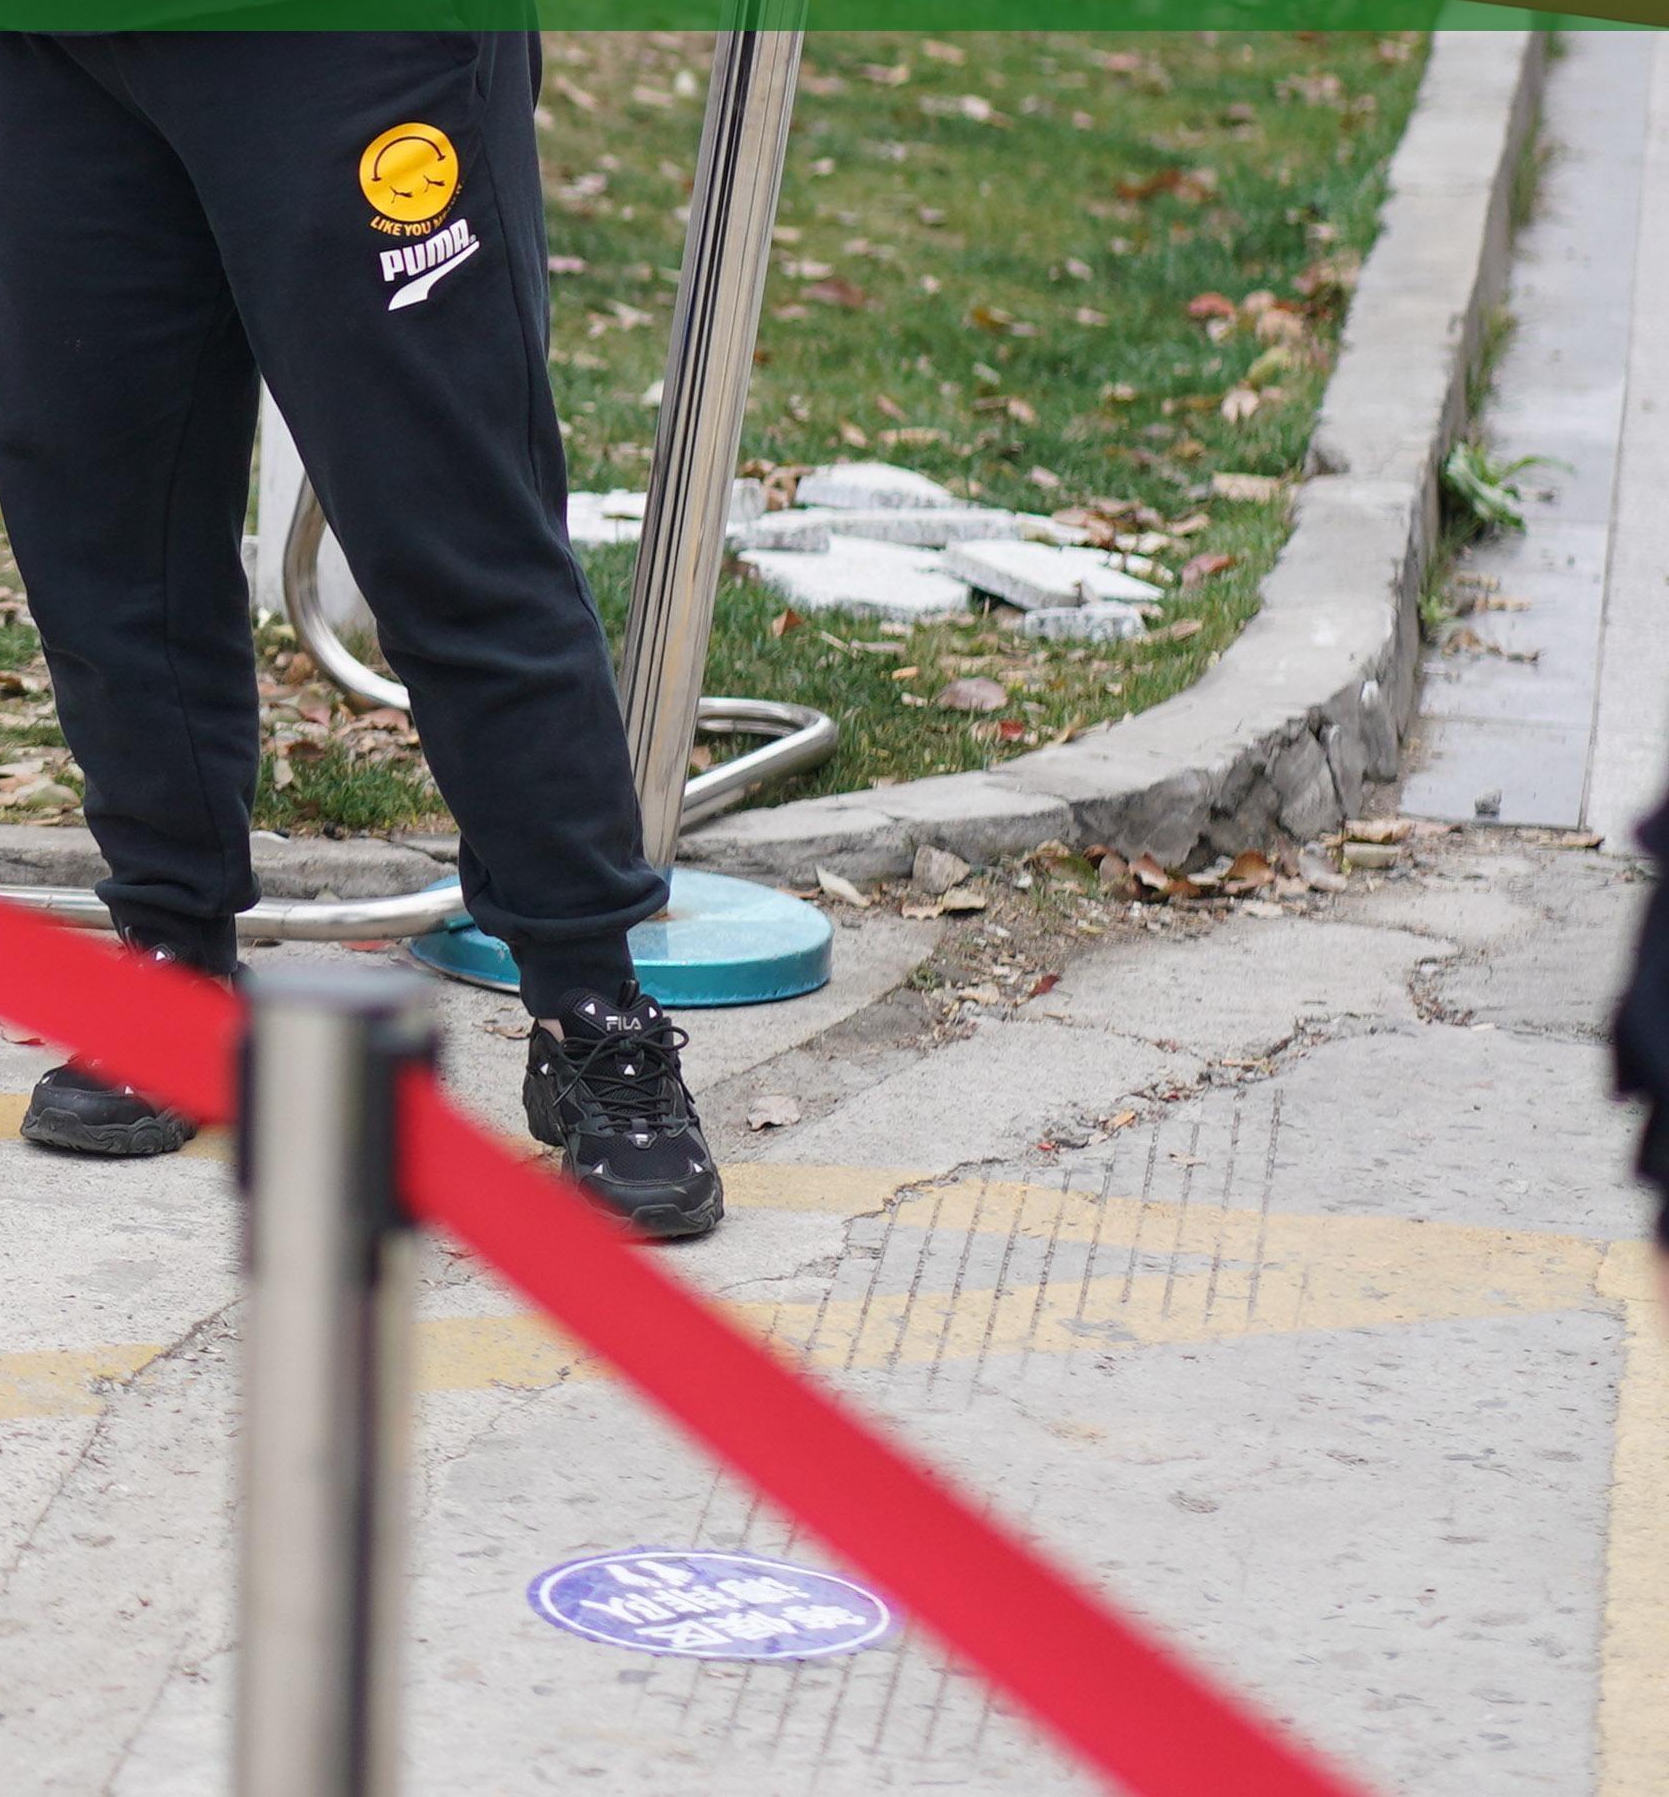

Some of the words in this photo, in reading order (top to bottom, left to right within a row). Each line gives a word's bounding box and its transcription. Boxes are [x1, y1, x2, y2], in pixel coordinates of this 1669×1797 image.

[369, 215, 402, 236] LIKE
[403, 221, 432, 237] YOU
[379, 218, 470, 282] PUMA
[605, 1015, 642, 1031] FILA
[580, 1577, 811, 1625] 请排队
[635, 1603, 867, 1649] 等候区
